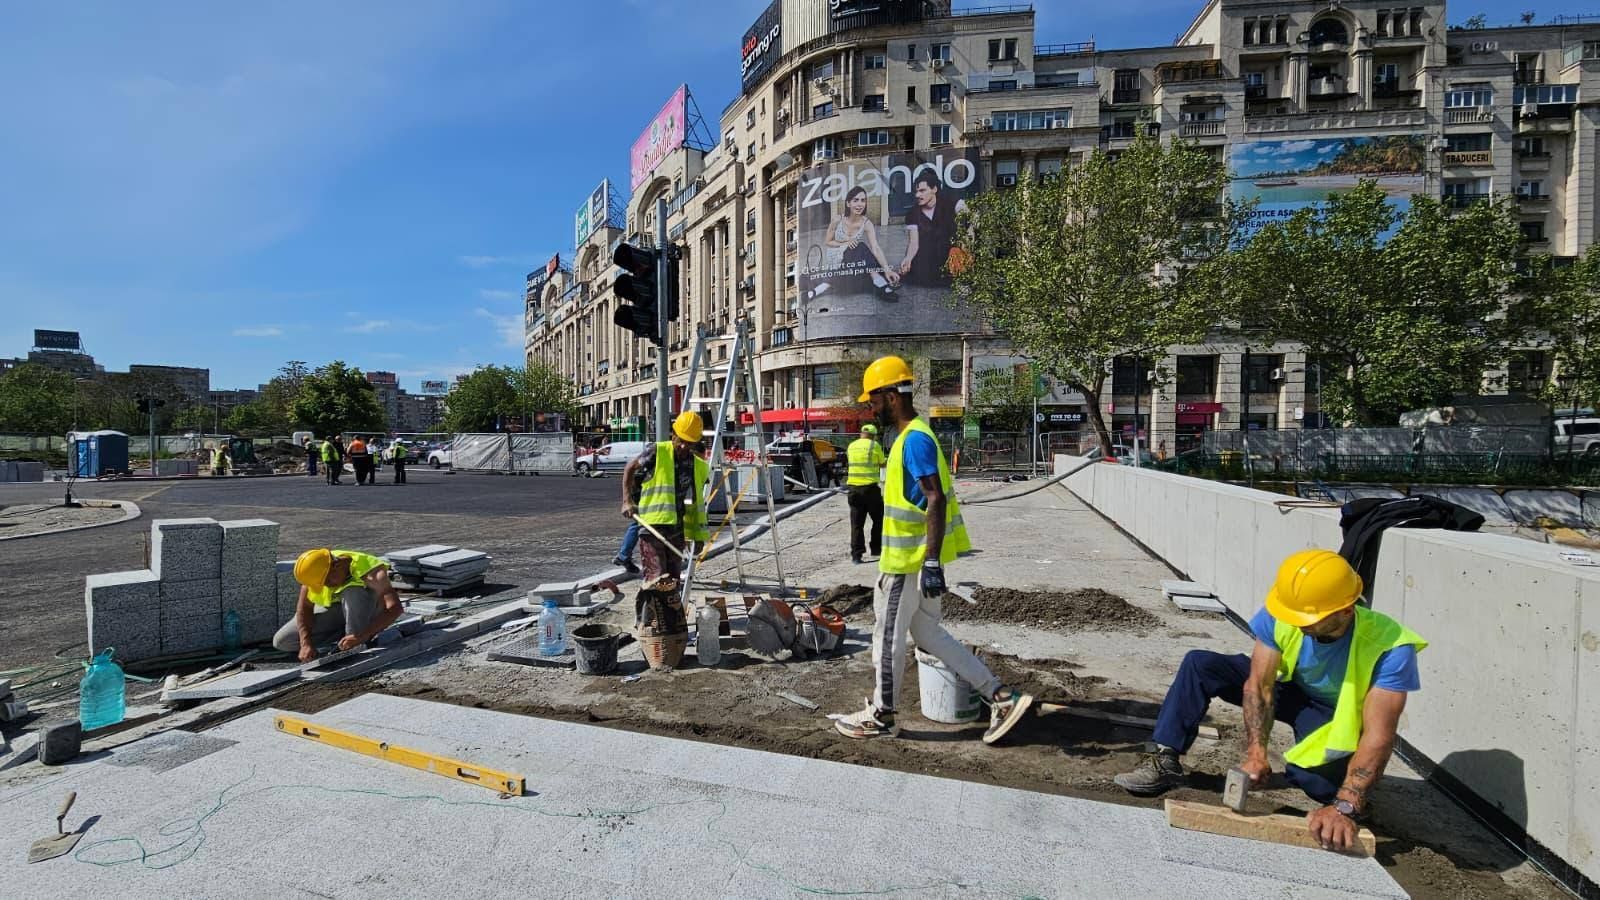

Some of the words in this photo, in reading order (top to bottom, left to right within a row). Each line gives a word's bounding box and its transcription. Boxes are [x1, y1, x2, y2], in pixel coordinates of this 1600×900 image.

[741, 24, 779, 76] gaming.ro
[1446, 153, 1489, 163] TRADUCERI
[801, 154, 976, 208] zalando
[834, 267, 854, 276] masă
[854, 267, 865, 276] pe
